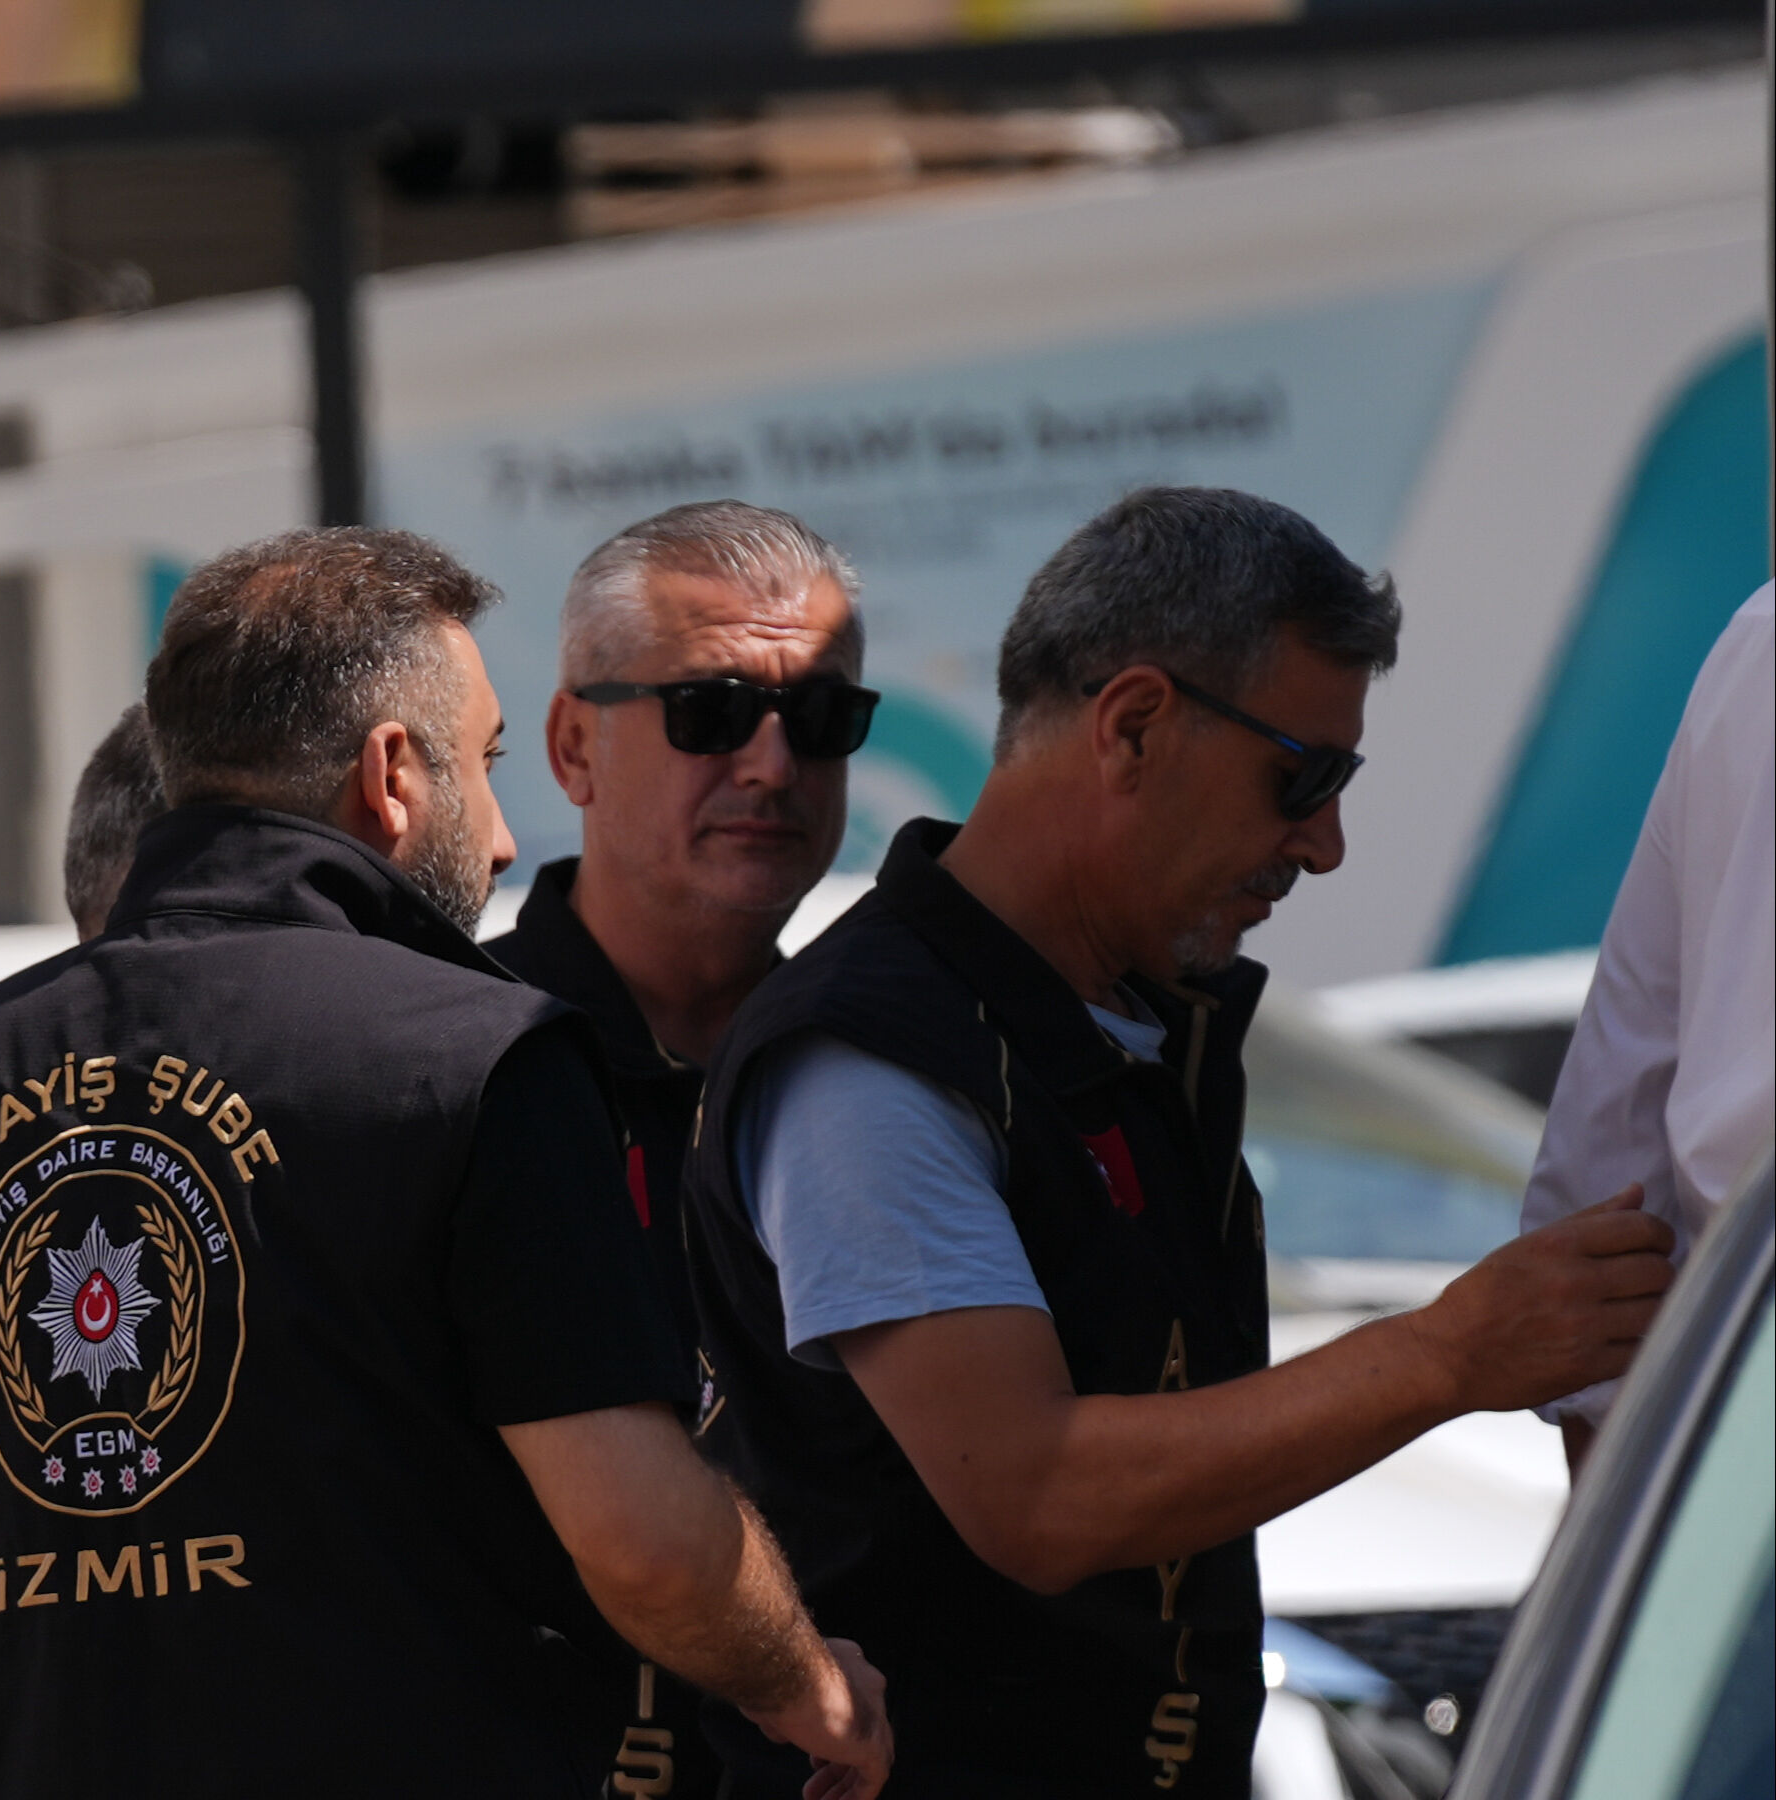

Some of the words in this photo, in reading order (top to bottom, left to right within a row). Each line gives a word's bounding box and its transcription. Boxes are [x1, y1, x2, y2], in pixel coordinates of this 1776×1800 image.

[148, 1054, 281, 1183] ŞUBE
[37, 1138, 117, 1181] DAİRE
[130, 1142, 229, 1264] BAŞKANLIĞI
[75, 1428, 137, 1459] EGM
